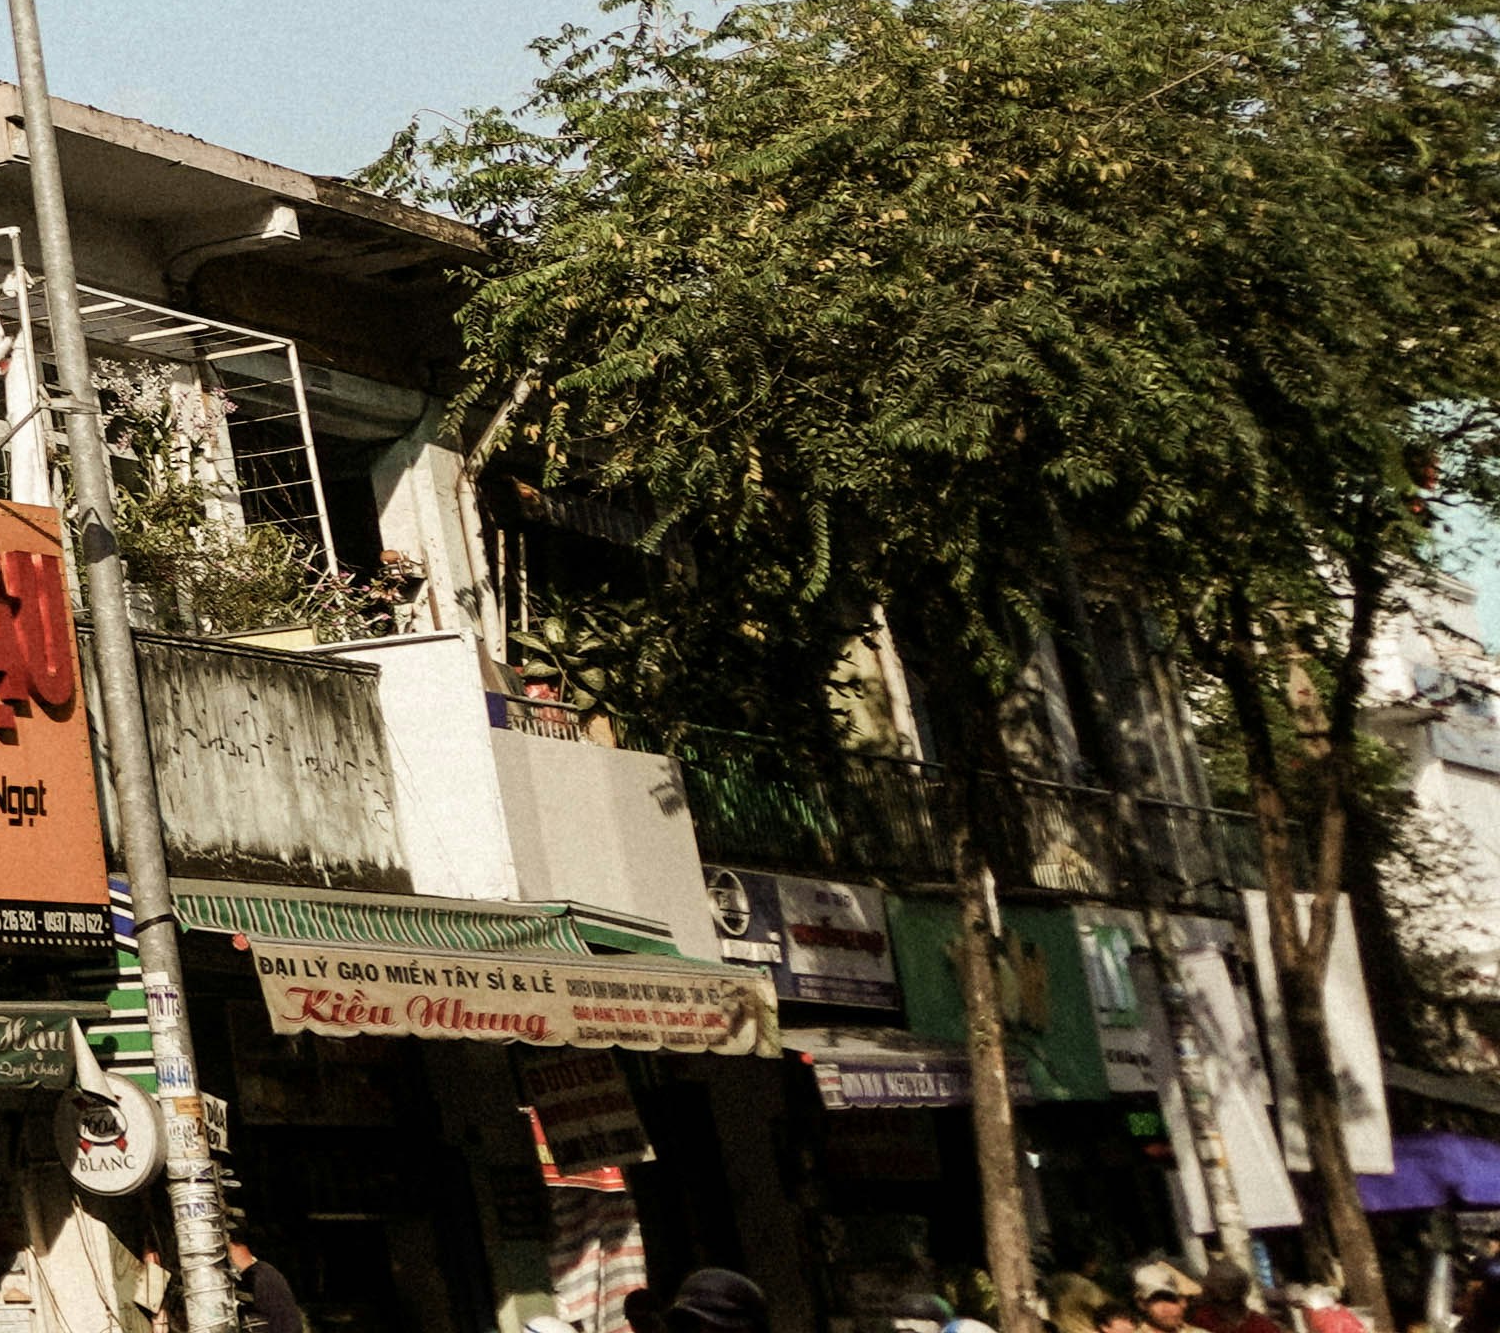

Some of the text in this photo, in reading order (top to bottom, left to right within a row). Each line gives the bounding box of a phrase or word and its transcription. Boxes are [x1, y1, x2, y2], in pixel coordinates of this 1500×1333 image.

[2, 909, 19, 932] 215
[19, 910, 37, 932] 521
[43, 910, 67, 933] 0937
[68, 912, 87, 934] 799
[86, 913, 105, 934] 622
[258, 955, 296, 979] ĐẠI
[303, 955, 329, 979] LÝ
[337, 960, 379, 985] GẠO
[385, 958, 438, 987] MIỀN
[442, 965, 480, 989] TÂY
[512, 974, 527, 991] &
[532, 968, 556, 994] LẺ
[280, 986, 400, 1028] Kiều
[406, 994, 558, 1041] Nhung
[79, 1154, 137, 1173] BLANC
